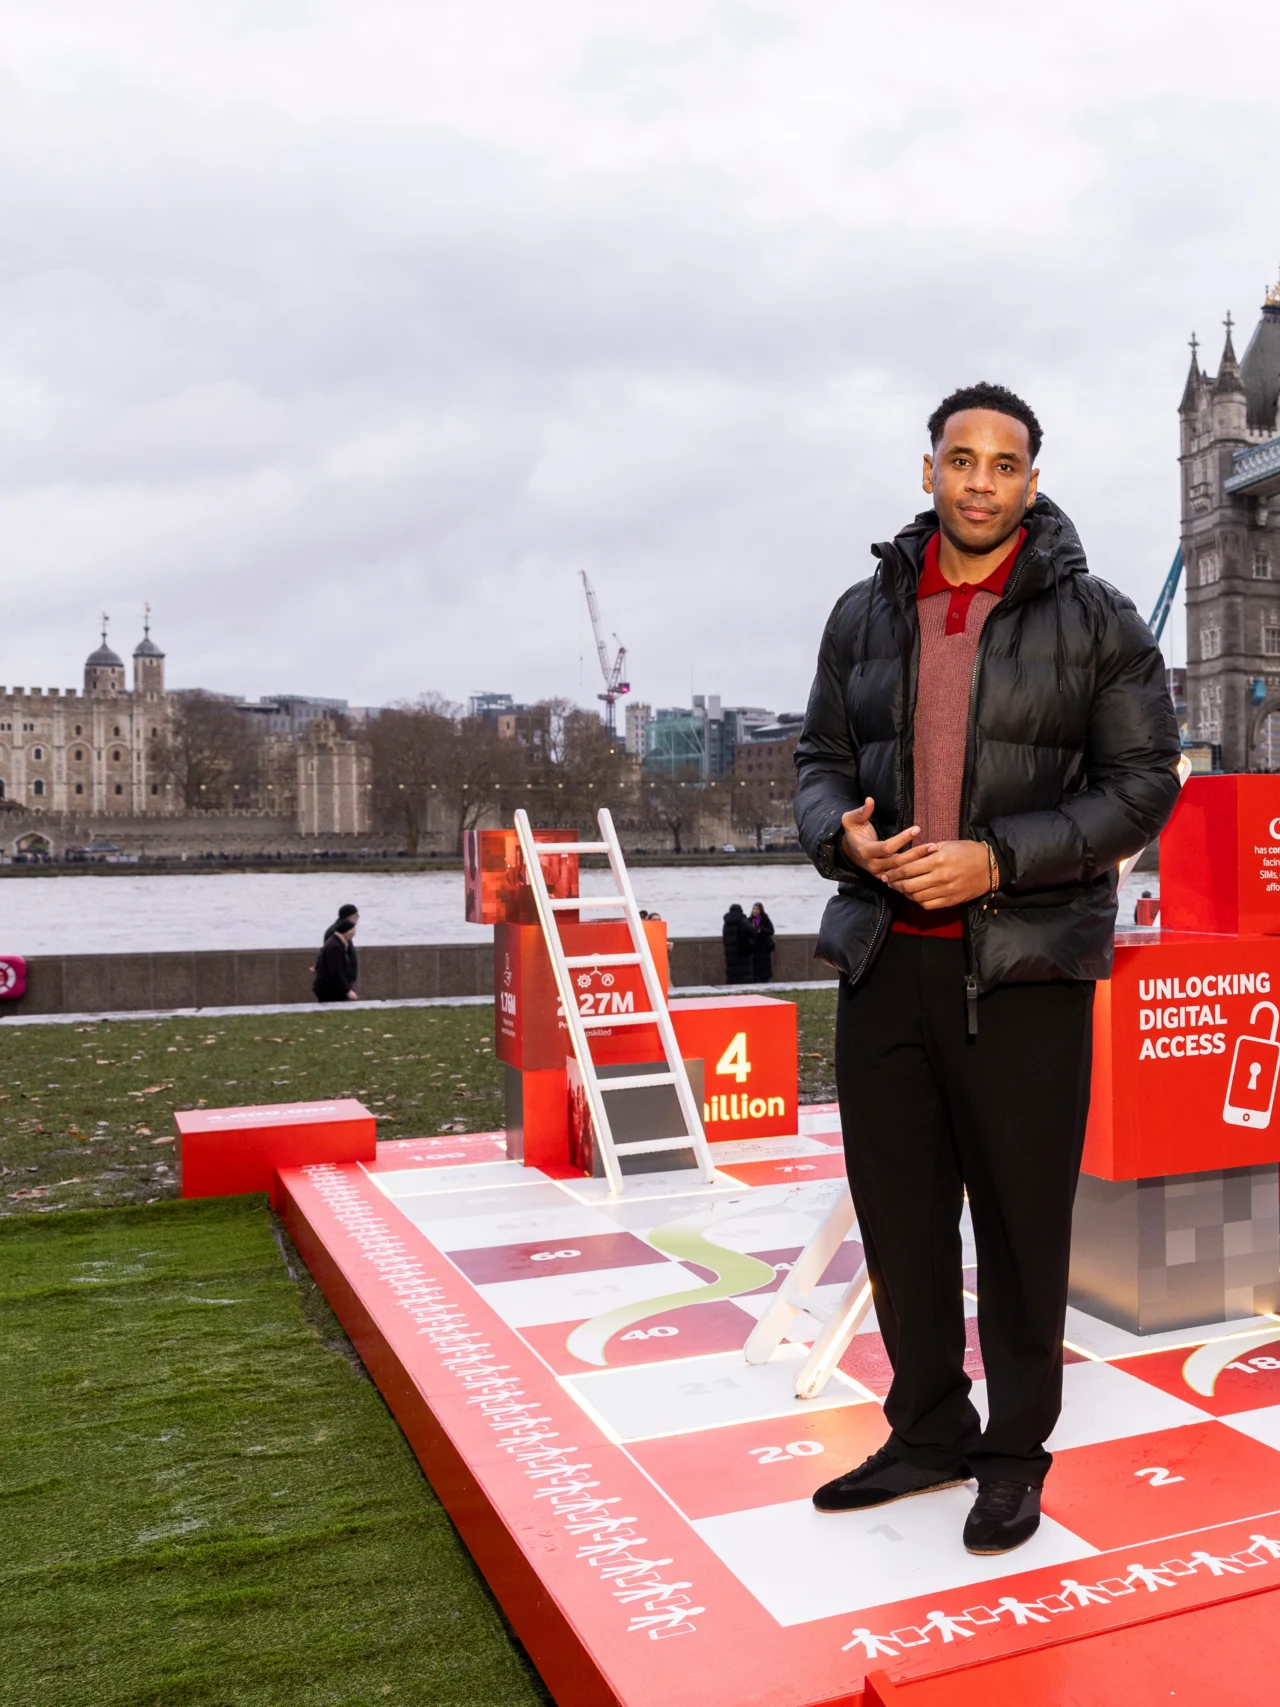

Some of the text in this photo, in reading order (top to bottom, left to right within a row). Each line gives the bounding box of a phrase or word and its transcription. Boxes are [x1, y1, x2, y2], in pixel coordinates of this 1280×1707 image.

[1254, 845, 1267, 854] has
[1259, 870, 1278, 880] SIMs,
[1138, 972, 1271, 1001] UNLOCKING
[501, 991, 516, 1016] 1.76M
[1139, 1003, 1228, 1031] DIGITAL
[585, 1028, 612, 1037] pskilled
[1138, 1032, 1226, 1060] ACCESS
[715, 1032, 751, 1083] 4
[409, 1152, 466, 1162] 100
[529, 1249, 583, 1263] 60
[619, 1325, 680, 1342] 40
[677, 1376, 742, 1398] 21
[748, 1439, 826, 1465] 20
[1133, 1466, 1186, 1487] 2
[865, 1522, 906, 1543] 1
